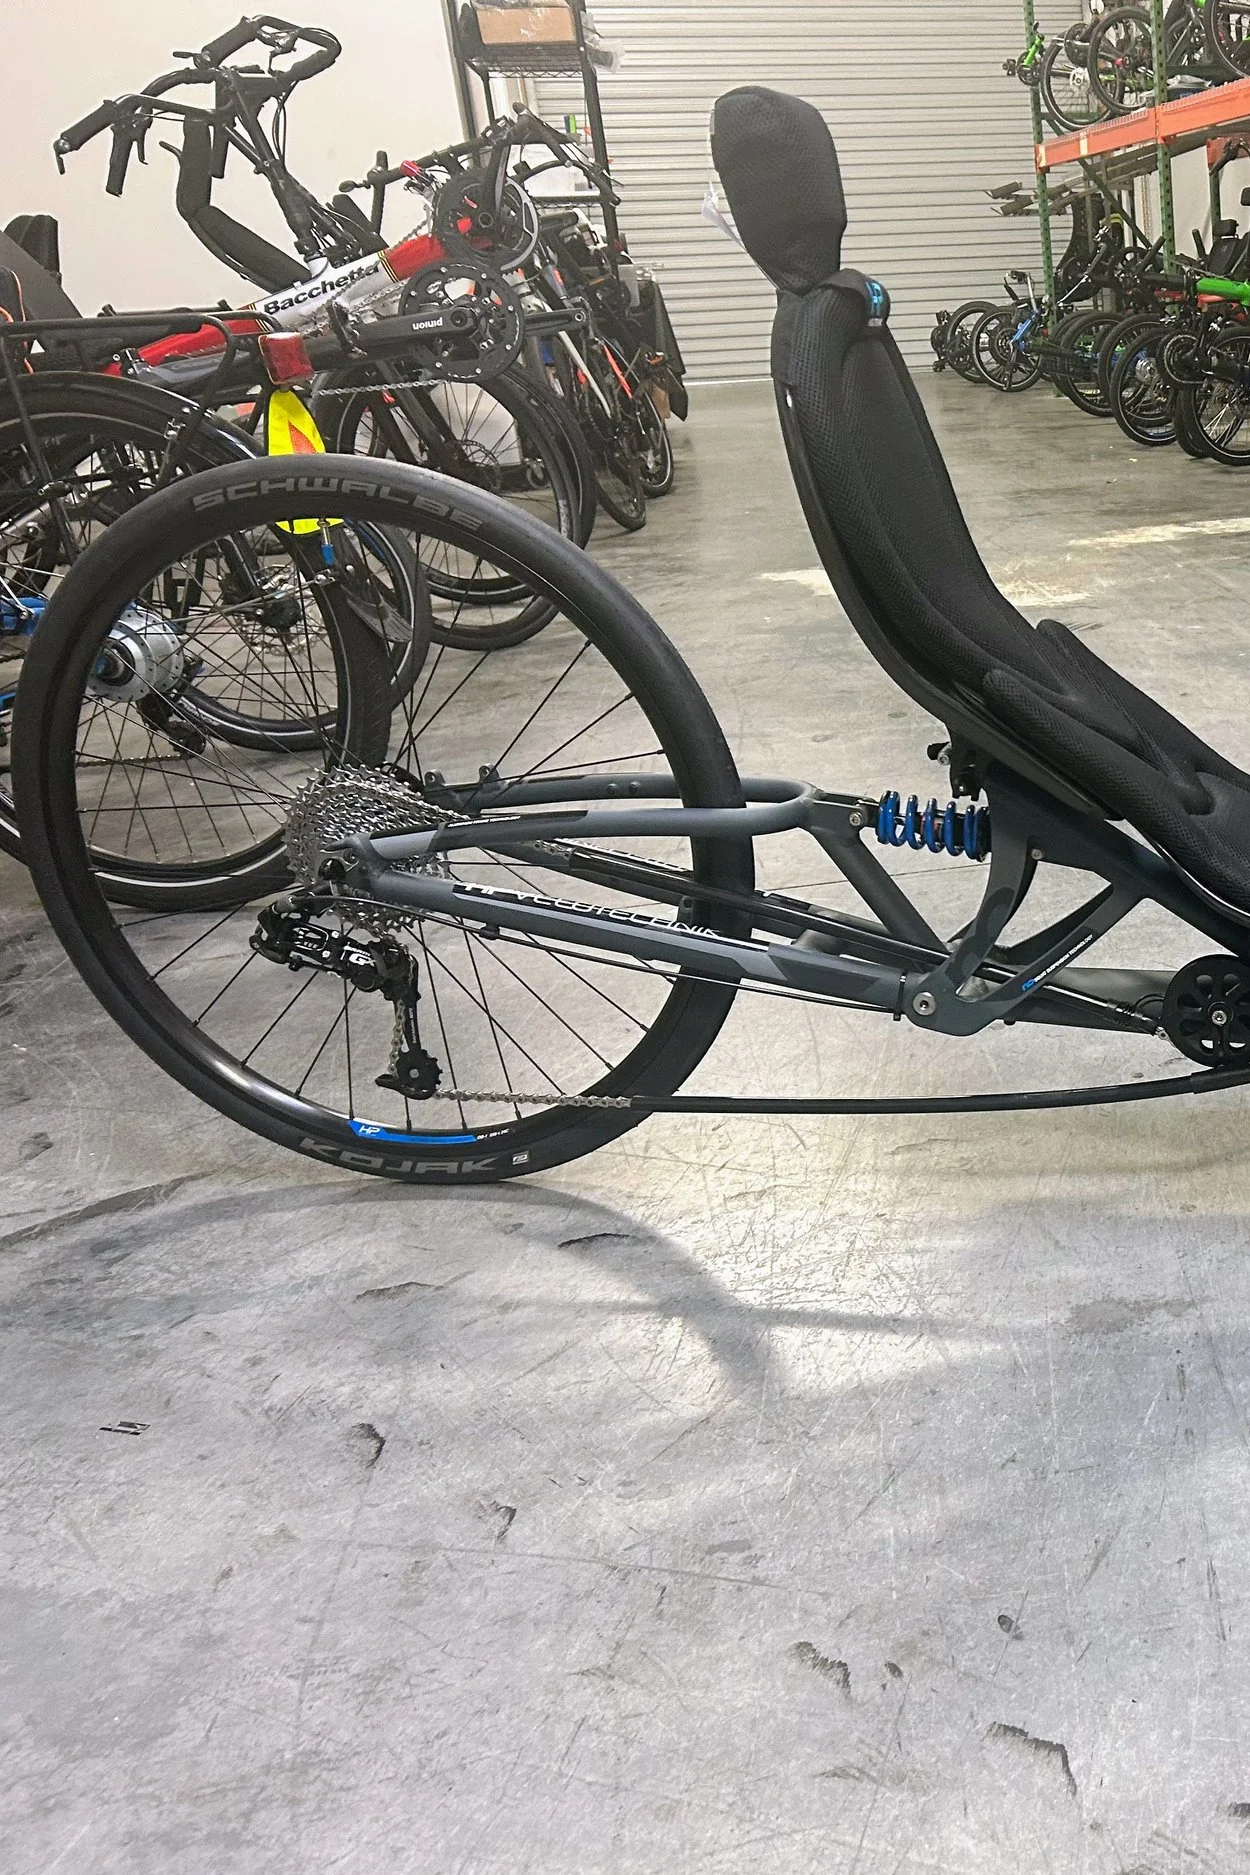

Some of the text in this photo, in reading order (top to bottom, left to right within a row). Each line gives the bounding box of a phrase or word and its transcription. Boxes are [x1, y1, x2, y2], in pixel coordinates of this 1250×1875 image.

[264, 259, 381, 315] Bacchetta
[412, 316, 444, 331] pinion
[192, 477, 485, 532] SCHWALBE
[1069, 934, 1093, 955] TECHNOLOGY
[359, 1124, 381, 1134] HP
[300, 1137, 497, 1174] KOJAK
